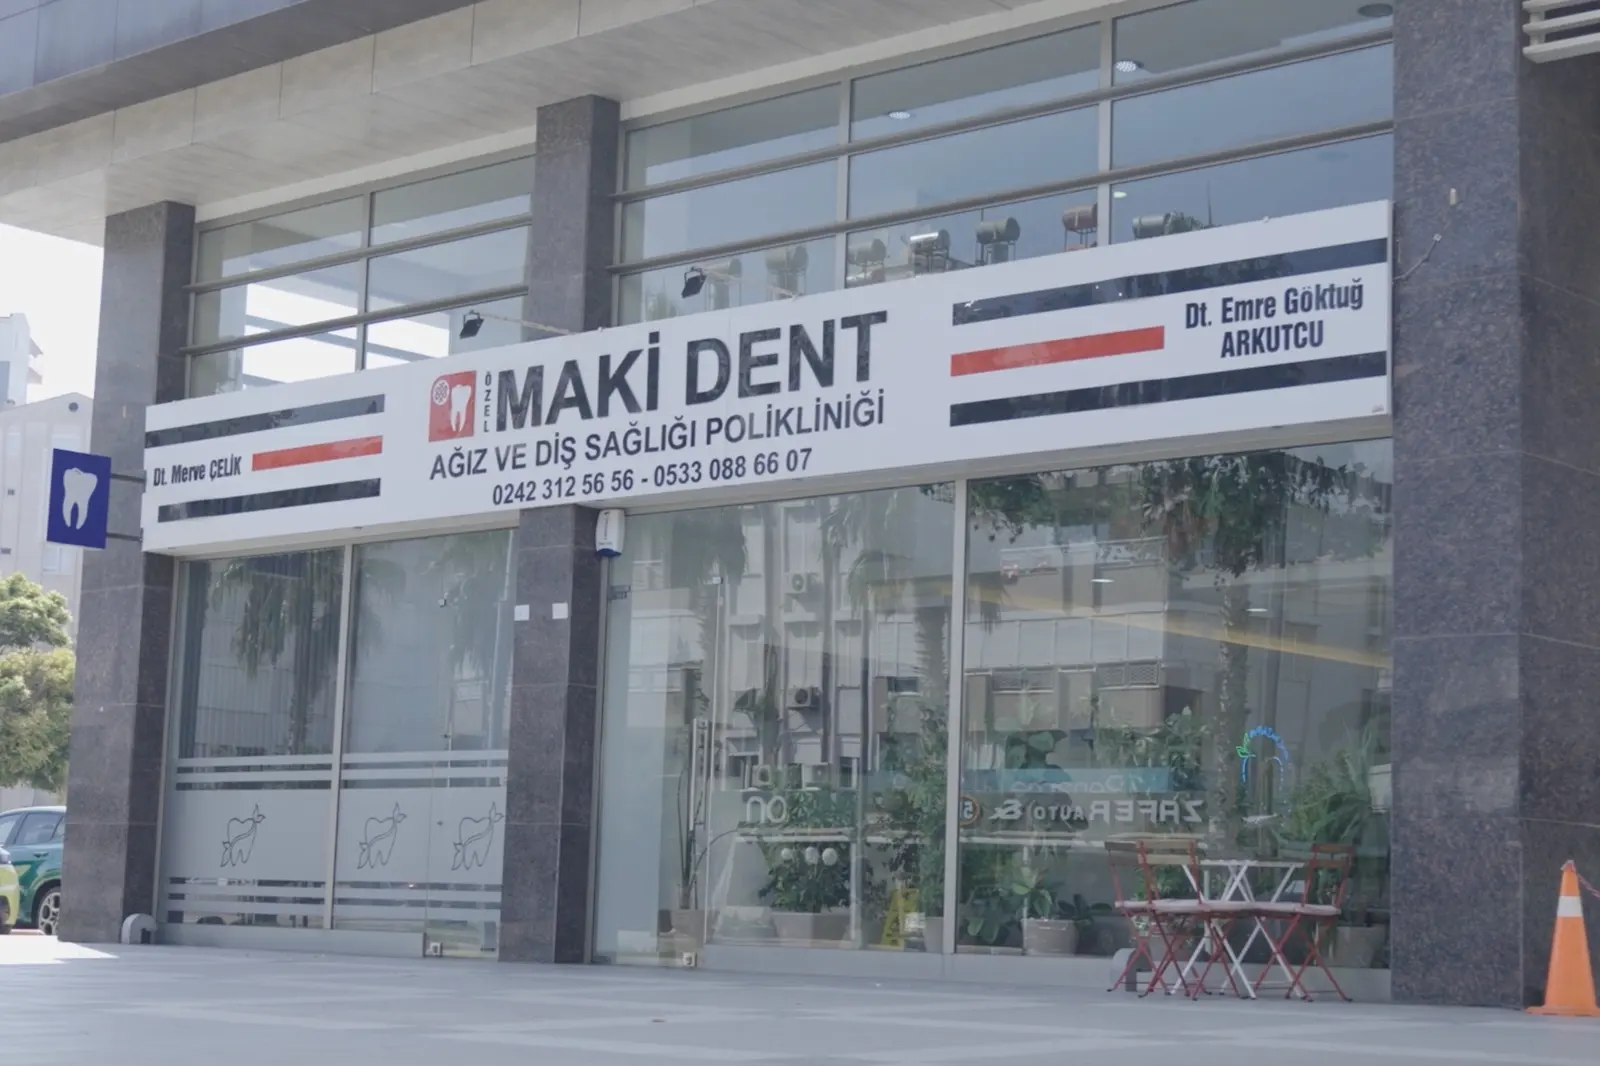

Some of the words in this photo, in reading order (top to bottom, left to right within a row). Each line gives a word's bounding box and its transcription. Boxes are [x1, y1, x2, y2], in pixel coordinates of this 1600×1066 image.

[1186, 302, 1213, 329] Dt.
[1221, 296, 1276, 324] Emre
[1284, 277, 1363, 315] Göktuğ
[1220, 320, 1324, 358] ARKUTCU
[496, 331, 661, 432] MAKİ
[686, 310, 888, 406] DENT
[483, 371, 492, 432] ÖZEL
[430, 446, 487, 480] AĞIZ
[495, 443, 527, 471] VE
[535, 432, 576, 470] DİŞ
[585, 415, 697, 460] SAĞLIĞI
[706, 389, 884, 445] POLİKLİNİĞİ
[153, 466, 169, 486] Dt.
[171, 464, 206, 484] Merve
[209, 454, 242, 482] ÇELİK
[493, 480, 536, 505] 0242
[542, 476, 575, 499] 312
[582, 472, 604, 495] 56
[611, 468, 633, 491] 56
[654, 461, 702, 487] 0533
[709, 456, 746, 480] 088
[754, 452, 779, 475] 66
[786, 448, 812, 472] 07
